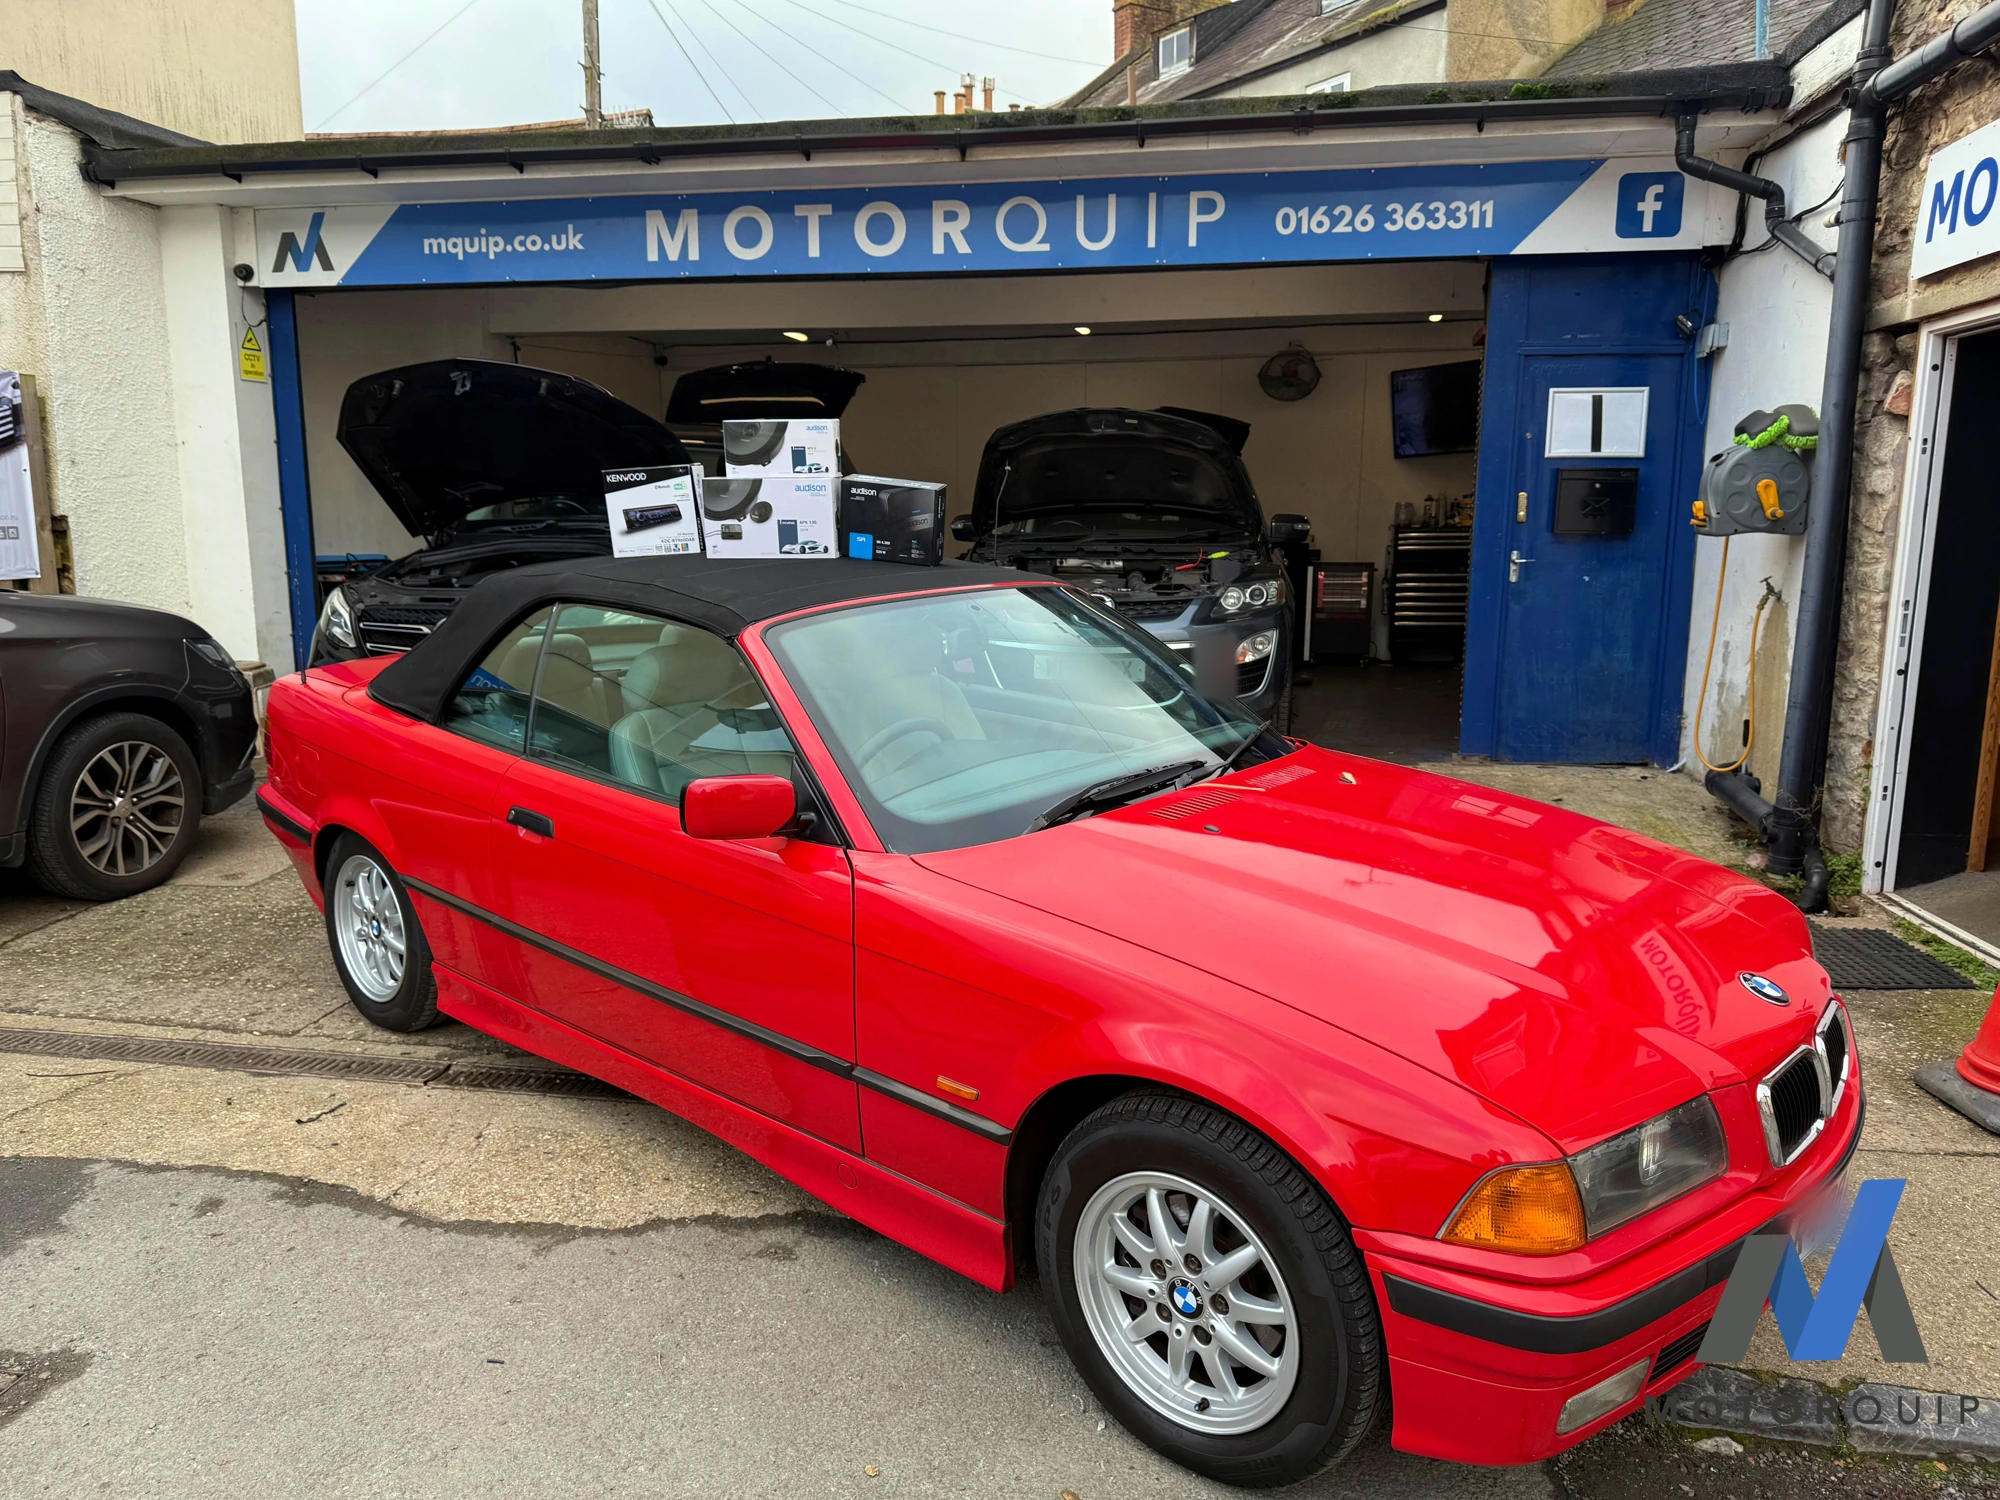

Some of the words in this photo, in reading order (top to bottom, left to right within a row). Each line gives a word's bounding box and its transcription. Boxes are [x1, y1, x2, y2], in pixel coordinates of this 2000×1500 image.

[1925, 157, 1998, 244] MO
[645, 190, 1226, 263] MOTORQUIP
[1275, 203, 1376, 236] 01626
[1384, 200, 1495, 232] 363311
[423, 225, 584, 260] mquip.co.uk
[244, 353, 260, 362] CCTV
[243, 369, 265, 377] operation
[606, 473, 647, 482] KENWOOD
[794, 484, 827, 492] audison
[850, 487, 877, 496] audison
[1174, 1279, 1204, 1305] BMW
